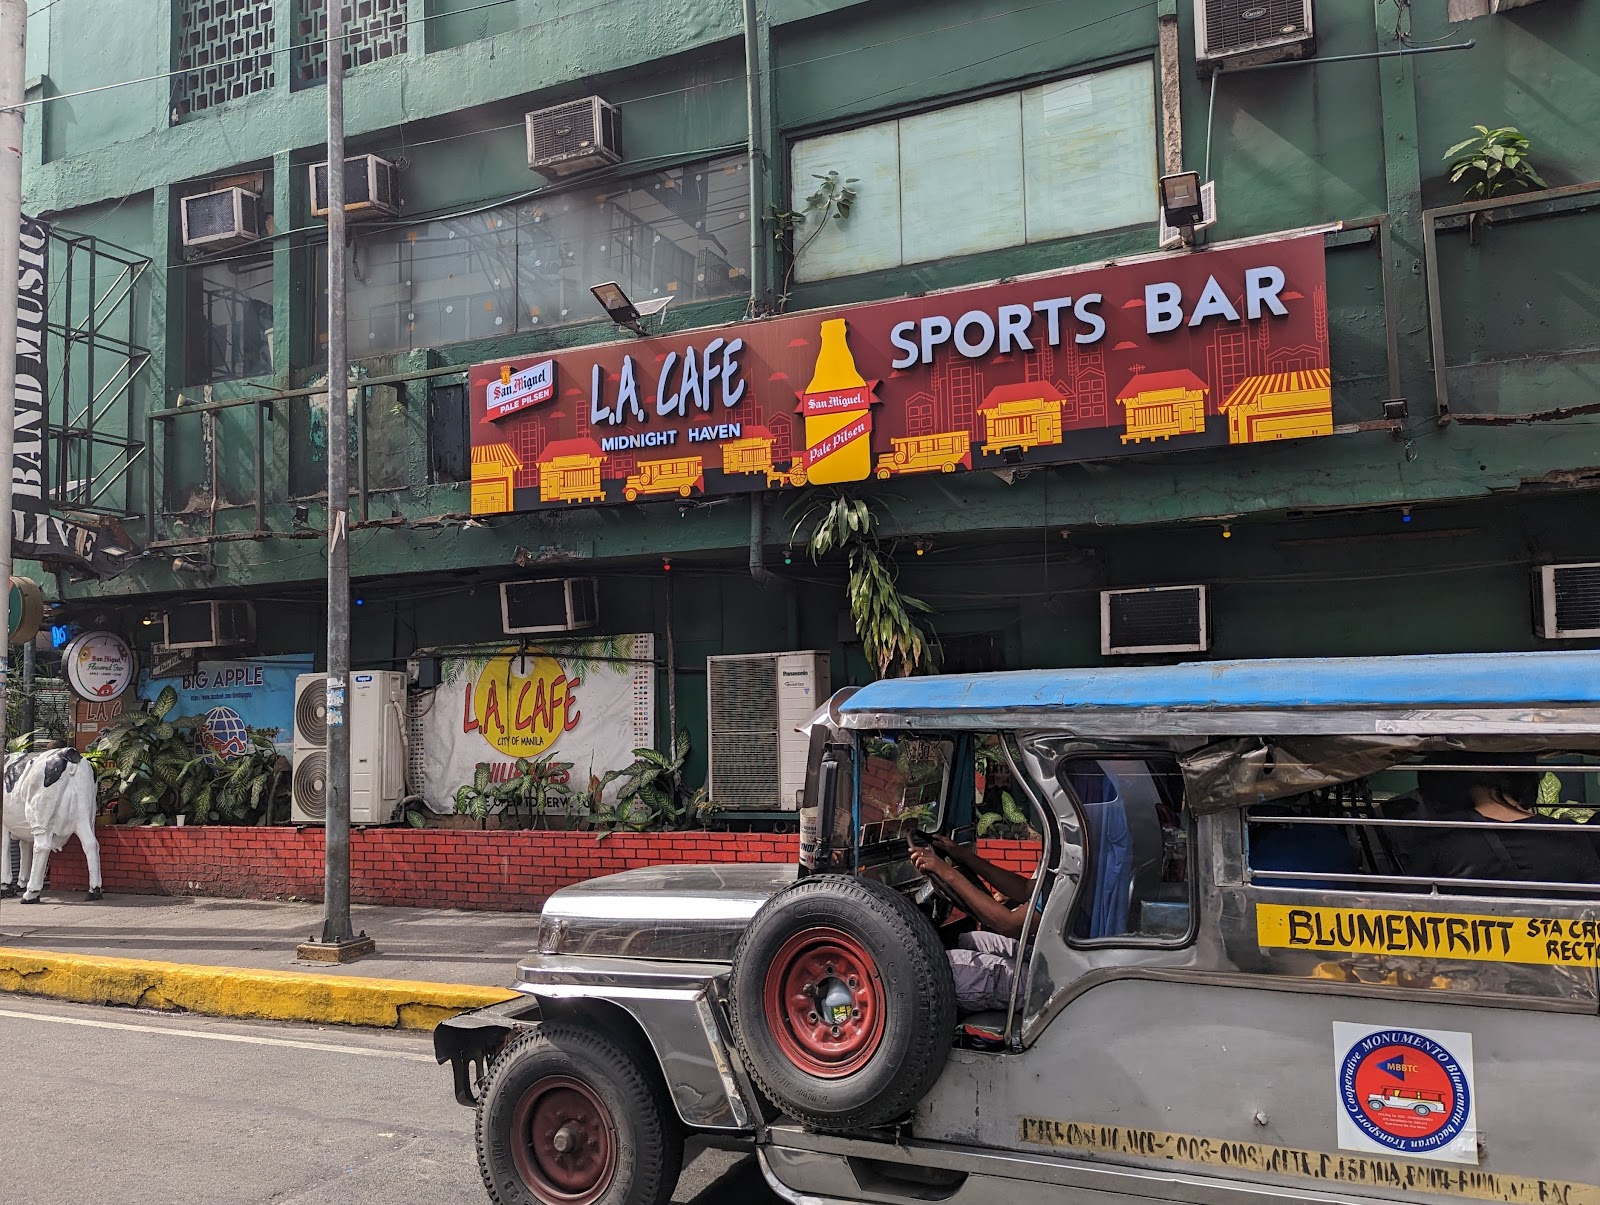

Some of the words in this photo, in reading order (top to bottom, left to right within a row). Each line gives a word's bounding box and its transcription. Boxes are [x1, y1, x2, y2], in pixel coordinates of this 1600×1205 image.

[16, 220, 47, 364] MUSIC
[890, 294, 1107, 369] SPORTS
[1144, 265, 1290, 335] BAR
[493, 385, 512, 400] San
[513, 368, 546, 395] Miguel
[591, 354, 645, 426] L.A.
[656, 337, 746, 417] CAFE
[500, 401, 520, 414] PALE
[521, 388, 550, 406] PILSEN
[808, 398, 827, 410] San
[828, 393, 861, 408] Miguel
[12, 374, 43, 500] BAND
[602, 429, 678, 451] MIDNIGHT
[688, 422, 742, 443] HAVEN
[809, 441, 832, 463] Pale
[833, 422, 865, 449] Pilsen
[12, 509, 98, 562] LIVE
[181, 670, 209, 690] BIG
[211, 665, 264, 688] APPLE
[463, 678, 506, 736] L.A.
[515, 674, 581, 733] CAFE
[497, 736, 510, 746] CITY
[511, 736, 520, 746] OF
[520, 735, 545, 746] MANILA
[1288, 909, 1515, 957] BLUMENTRITT
[1526, 918, 1563, 938] STA
[1569, 920, 1600, 940] CR
[1361, 1032, 1450, 1063] MONUMENTO
[1344, 1051, 1362, 1113] Cooperative
[1386, 1062, 1419, 1073] MBBTC
[1445, 1063, 1466, 1127] Blumentritt
[1354, 1114, 1407, 1149] Transport
[1410, 1123, 1457, 1149] baclaran
